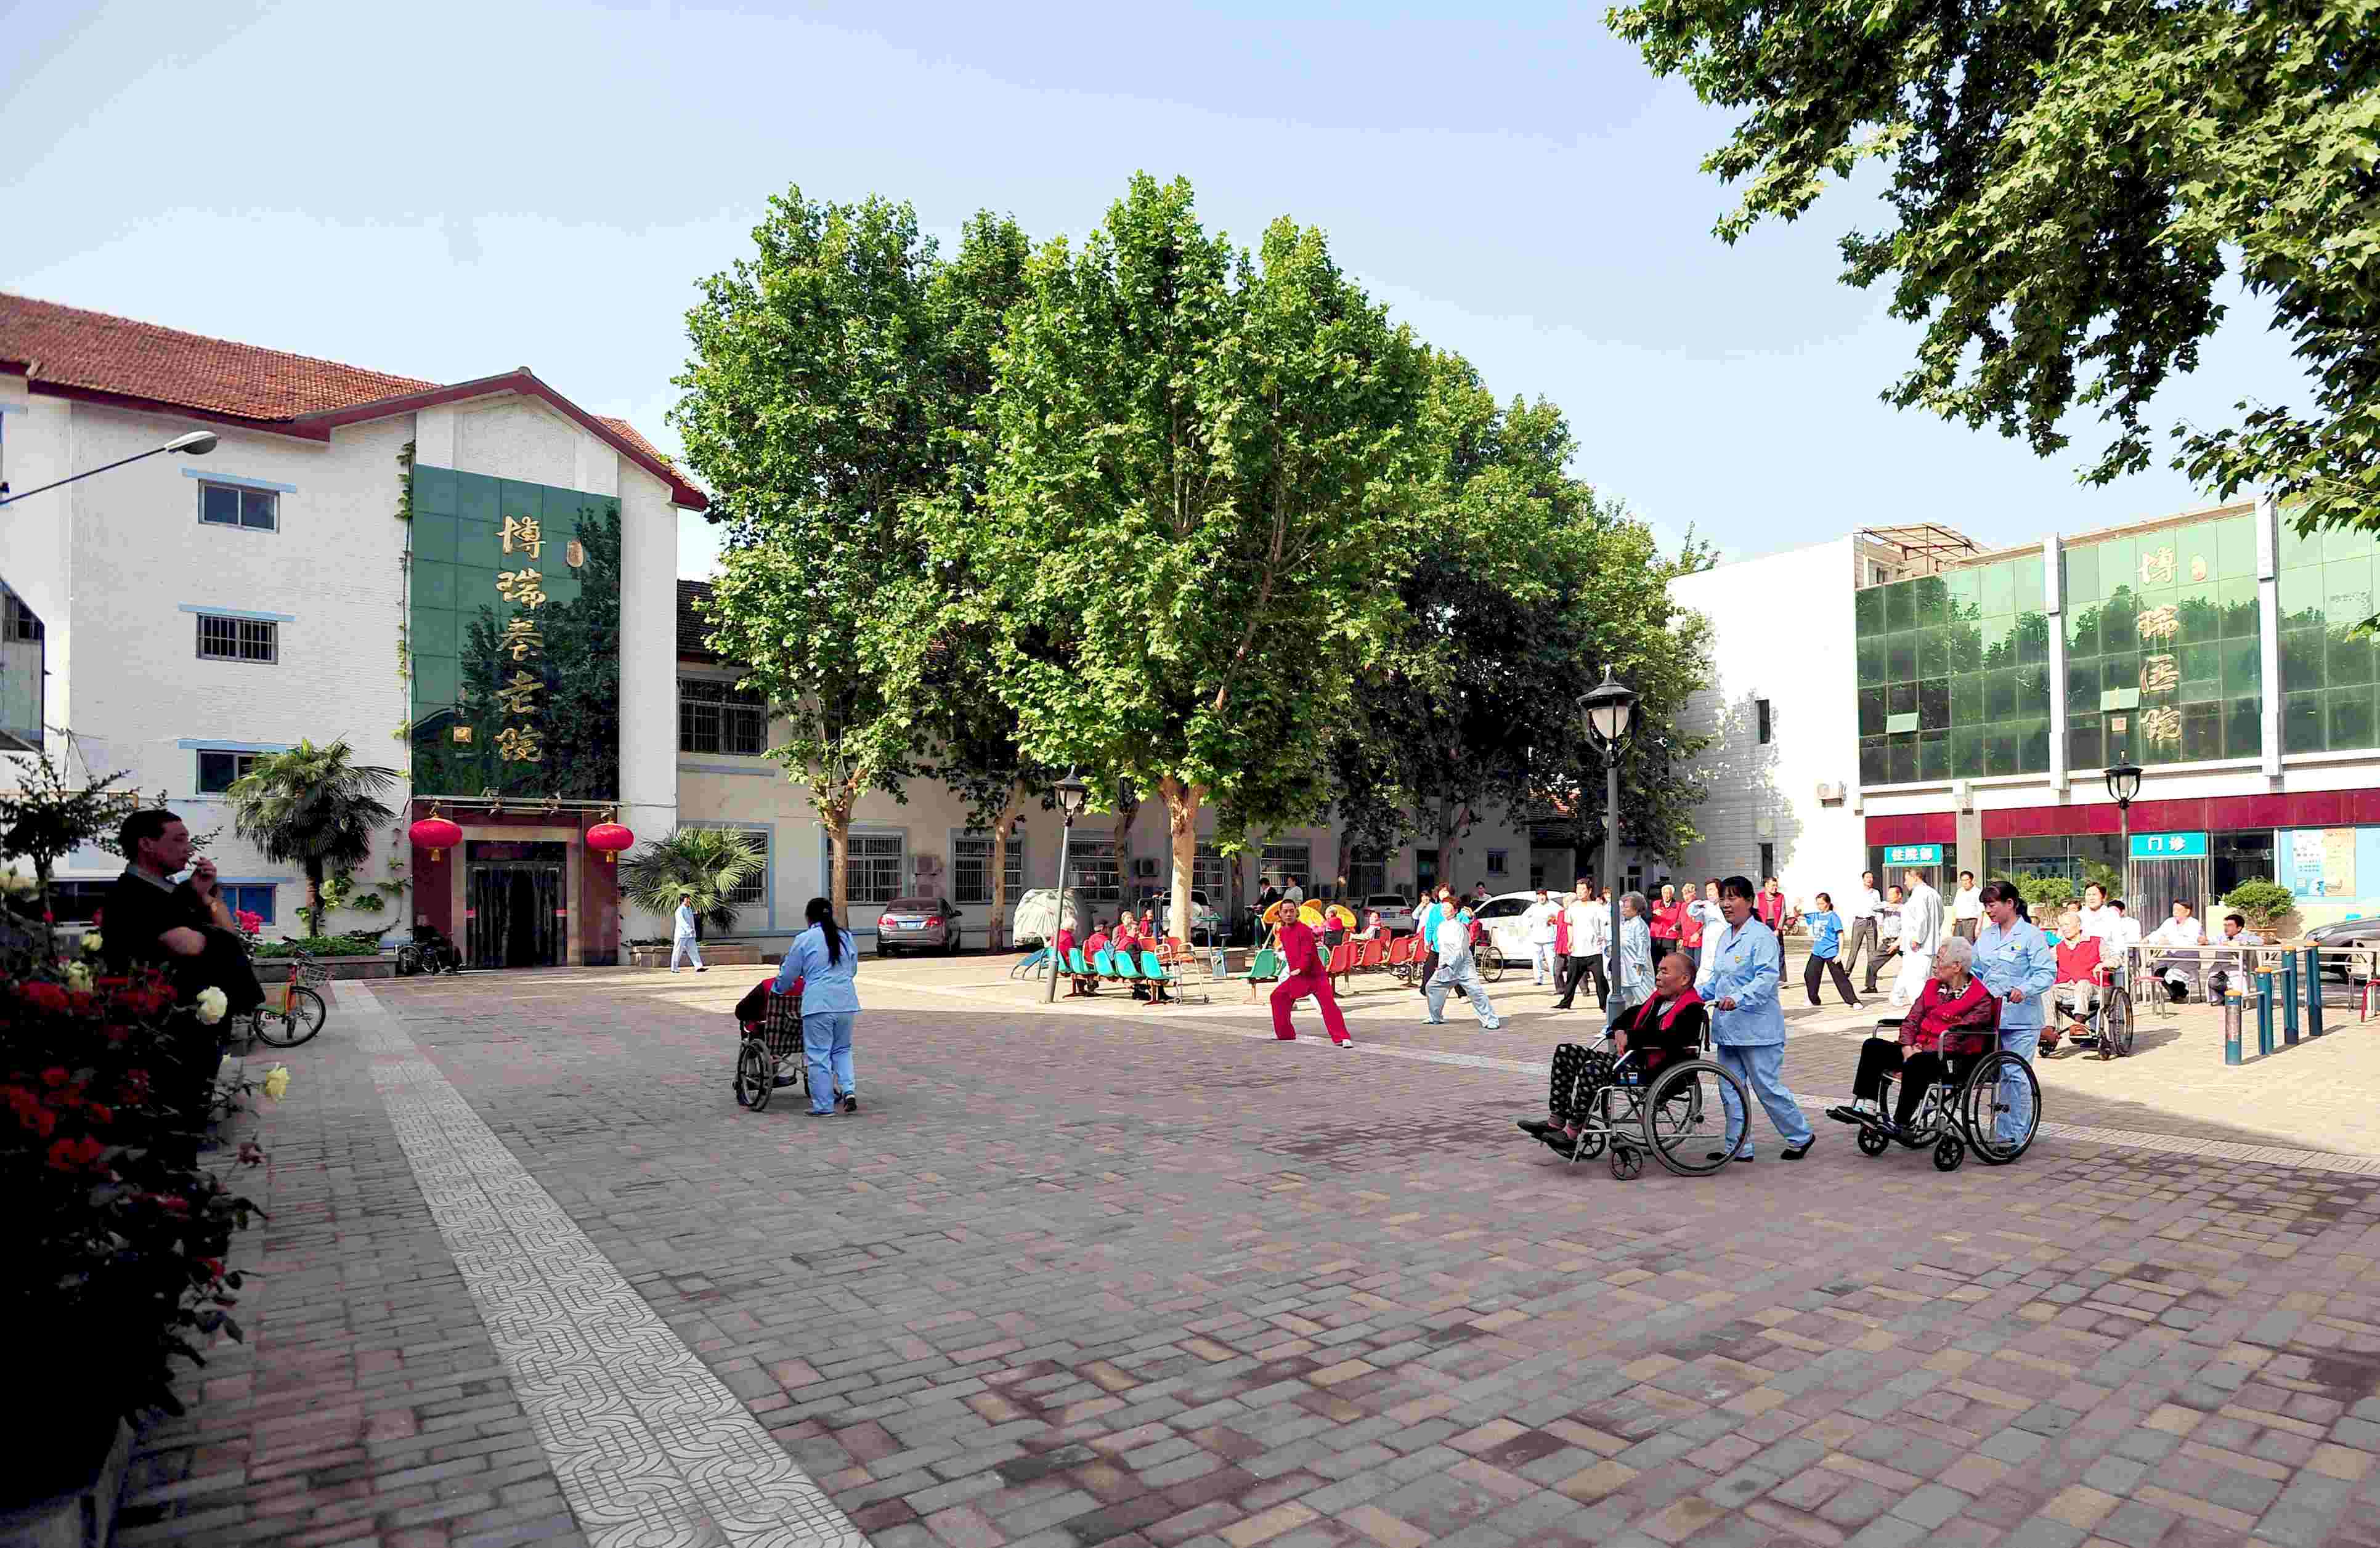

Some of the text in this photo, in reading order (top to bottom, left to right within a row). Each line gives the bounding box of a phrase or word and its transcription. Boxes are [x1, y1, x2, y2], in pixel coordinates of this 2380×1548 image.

[2148, 836, 2186, 852] 门诊
[1891, 847, 1933, 861] 住院部
